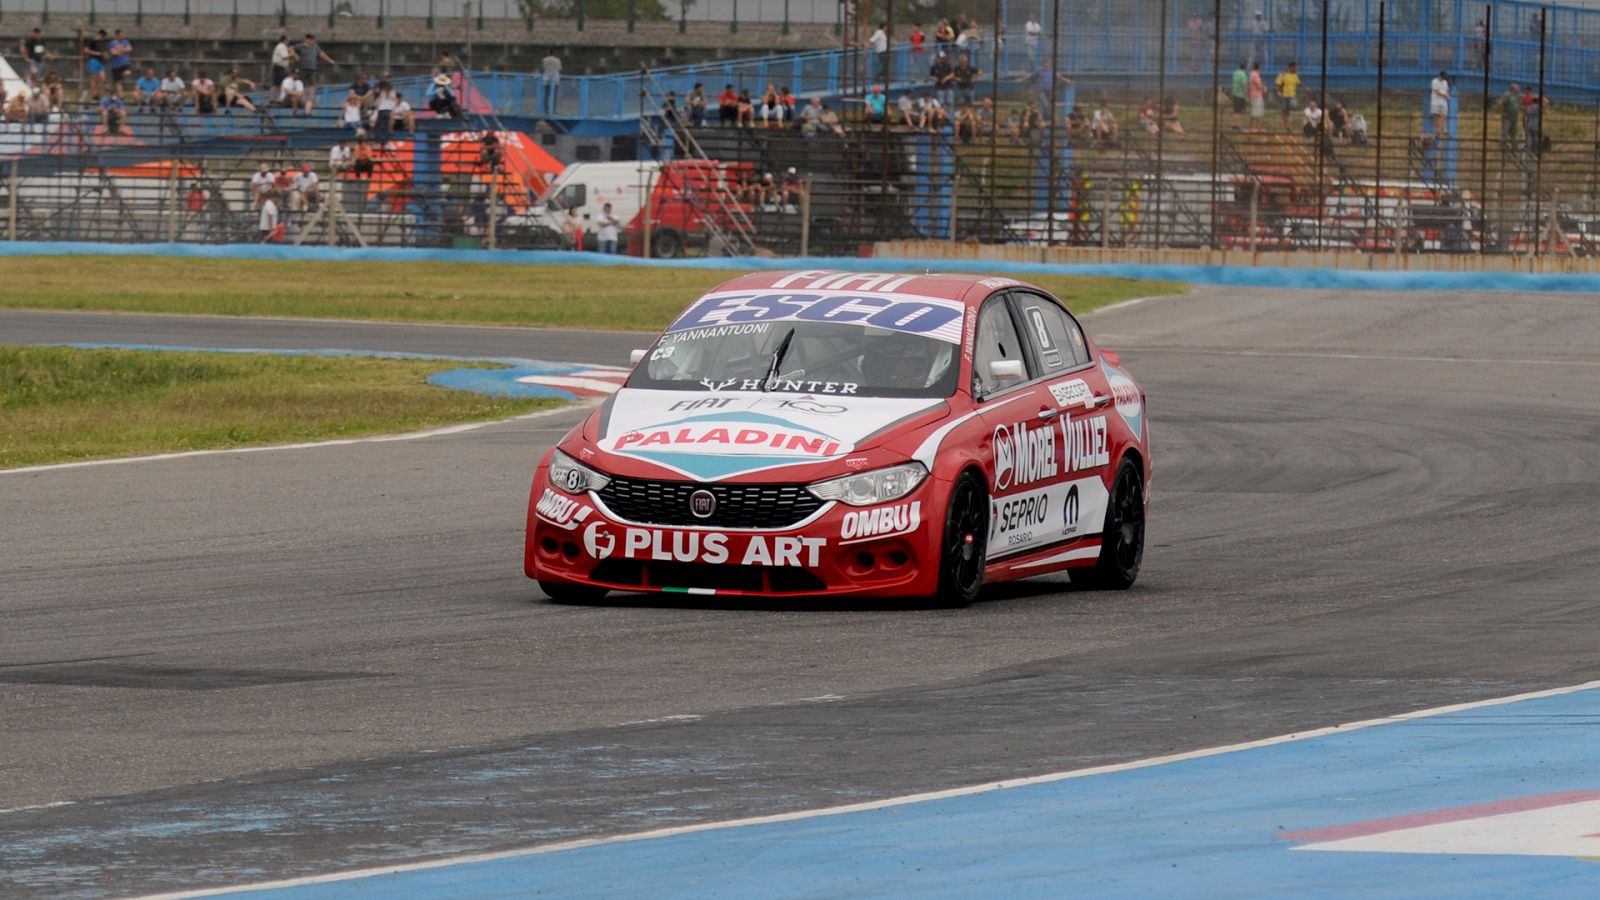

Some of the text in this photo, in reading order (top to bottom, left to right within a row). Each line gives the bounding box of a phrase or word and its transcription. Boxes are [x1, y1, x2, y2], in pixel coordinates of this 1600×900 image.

[770, 270, 922, 293] FIAT
[665, 294, 963, 333] ESCO
[673, 323, 770, 343] YANNANTUONI
[1032, 311, 1050, 348] 8
[650, 346, 676, 361] C3
[667, 398, 741, 412] FIAT
[613, 428, 841, 457] PALADINI
[1013, 412, 1110, 487] MOREL VULLIEZ
[566, 469, 580, 491] 8
[695, 498, 711, 512] FIAT
[1000, 493, 1048, 533] SEPRIO
[625, 527, 827, 567] PLUS ART
[1008, 531, 1032, 547] ROSARIO
